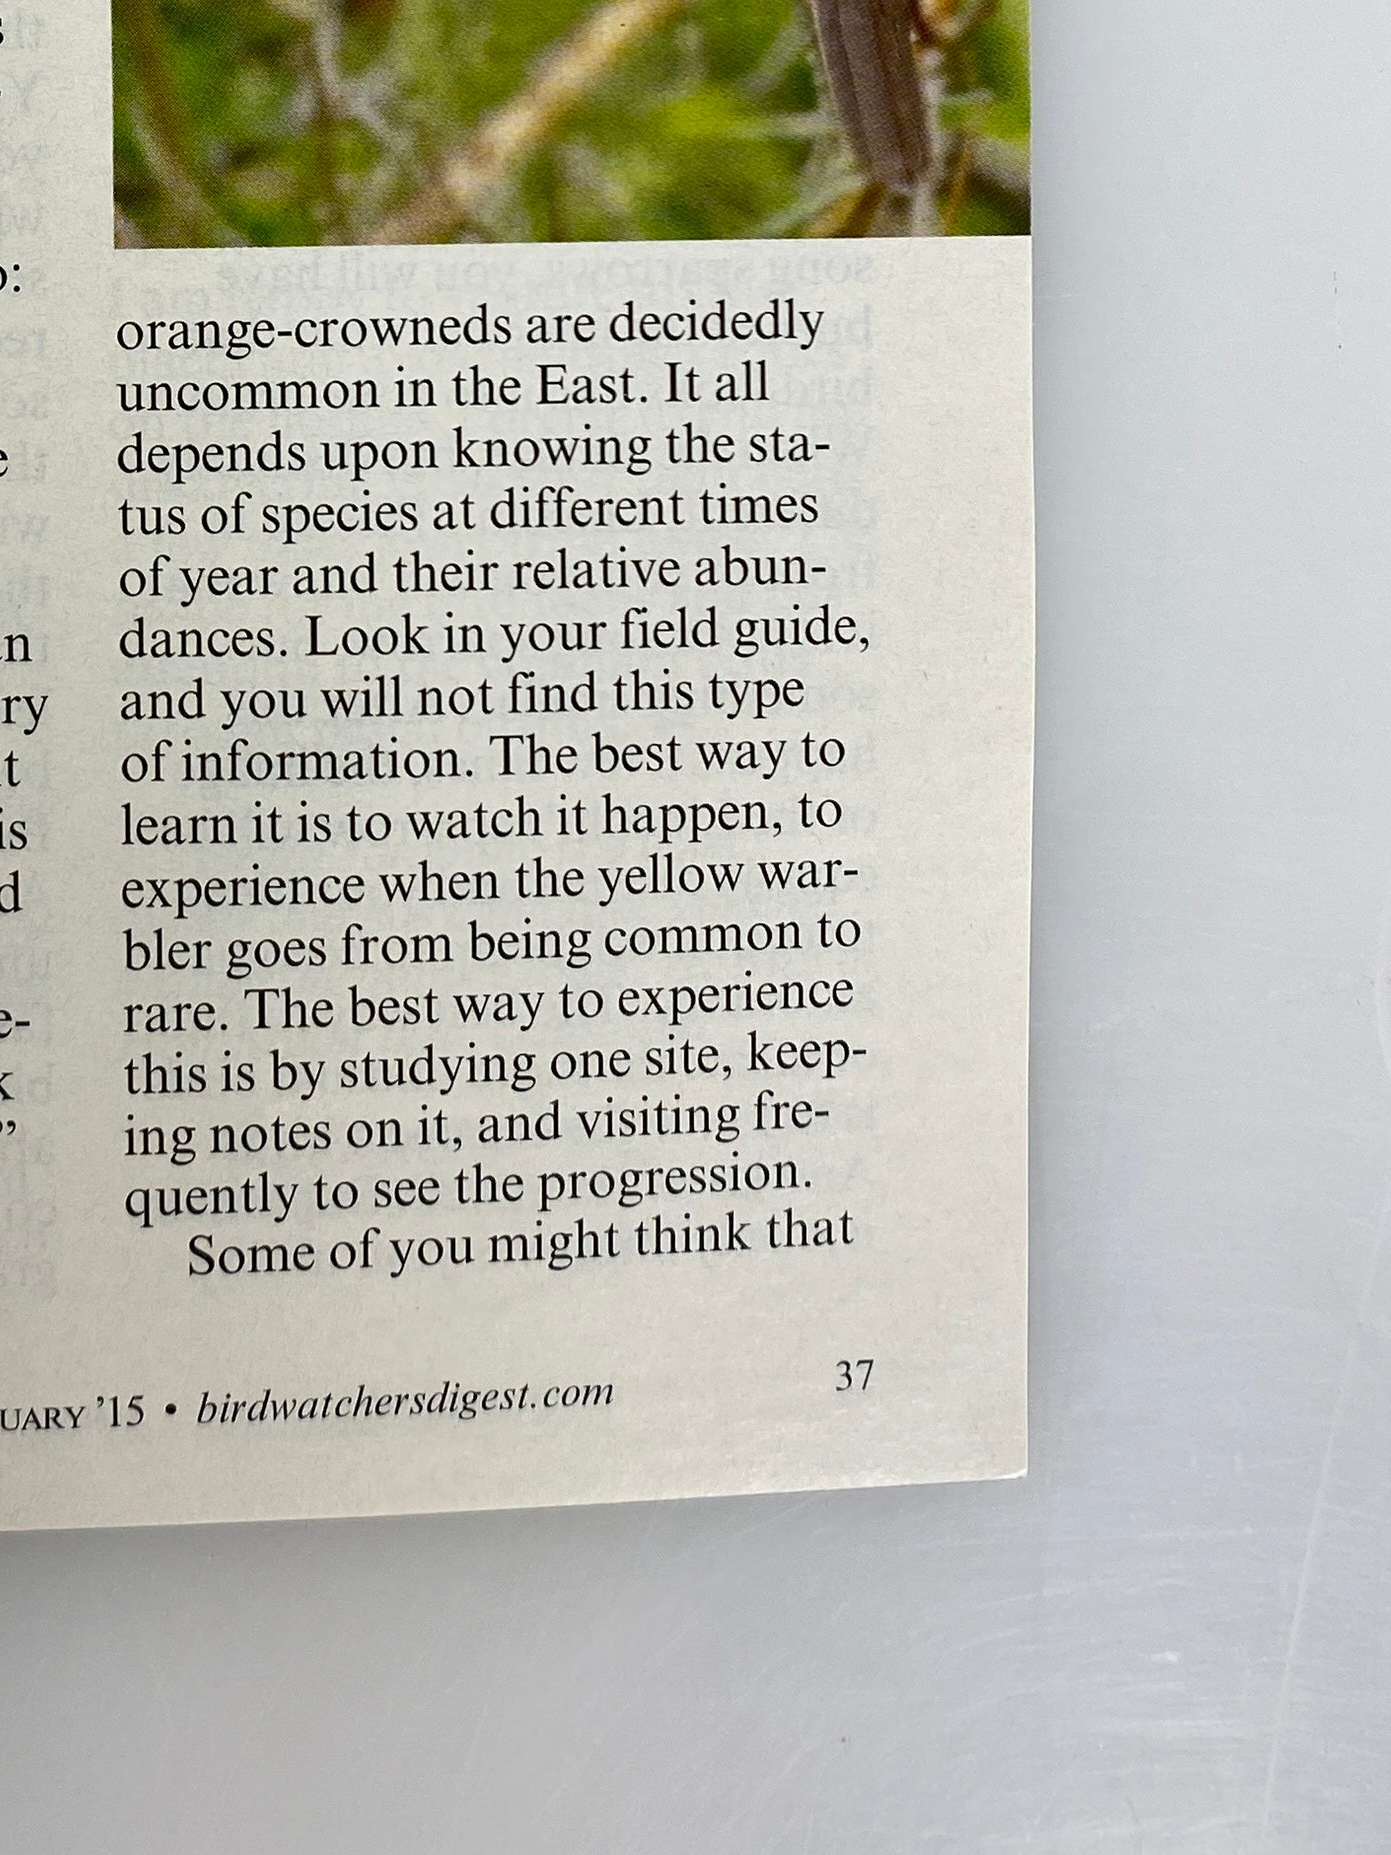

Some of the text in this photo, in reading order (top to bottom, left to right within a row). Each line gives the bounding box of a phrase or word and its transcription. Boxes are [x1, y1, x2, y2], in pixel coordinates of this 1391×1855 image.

[117, 298, 824, 360] orange-crowneds are decidedly
[116, 360, 769, 411] uncommon in the East. It all
[118, 422, 829, 484] depends upon knowing the sta-
[118, 483, 818, 544] tus of species at different times
[120, 604, 869, 663] dances. Look in your field guide,
[122, 852, 858, 919] experience when the yellow war-
[126, 1151, 810, 1228] quently to see the progression.
[189, 1208, 854, 1278] Some of you might think that
[198, 1381, 613, 1423] birdwatchersdigest.com
[836, 1359, 873, 1391] 37
